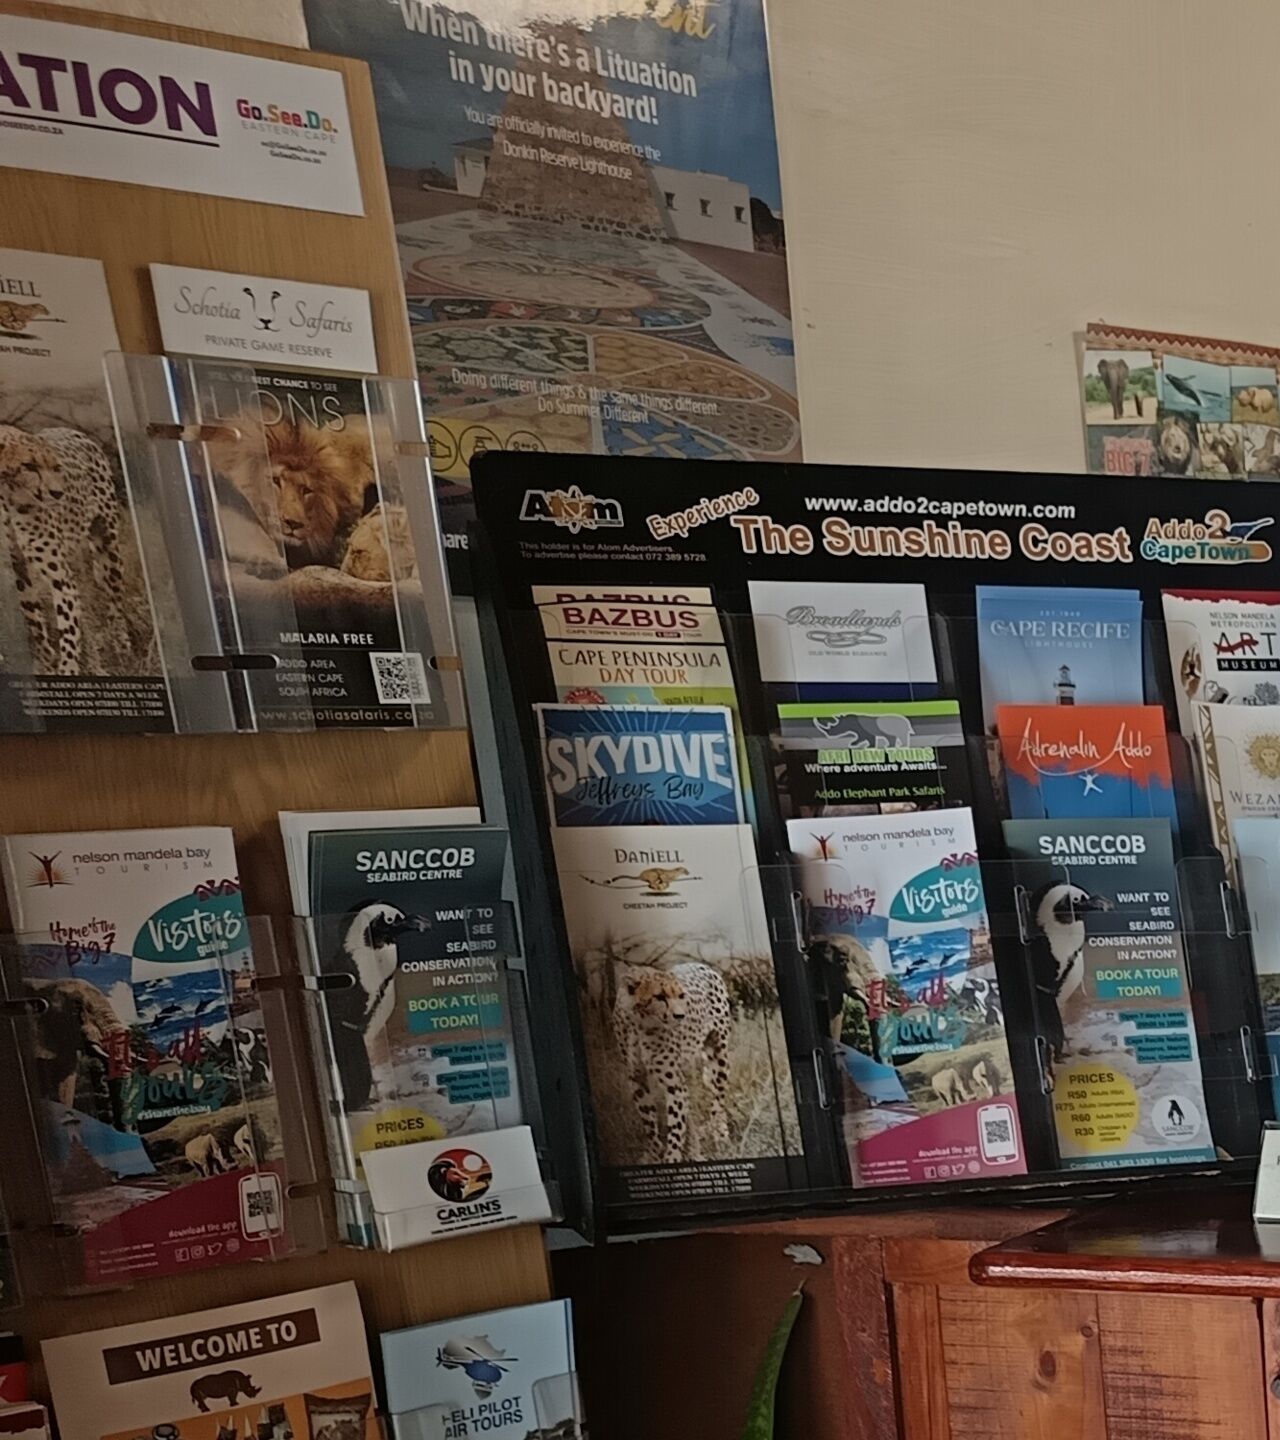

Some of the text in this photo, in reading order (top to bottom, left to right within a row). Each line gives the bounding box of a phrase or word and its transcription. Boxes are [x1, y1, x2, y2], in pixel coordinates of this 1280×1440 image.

[400, 1, 698, 97] When there's a Lituation
[448, 50, 660, 125] in your backyard!
[464, 104, 662, 162] You are officially invited to experience the
[503, 140, 633, 181] Donkin Reserve Lighthouse
[174, 285, 353, 340] Schotia Safaris
[204, 334, 333, 359] PRIVATE GAME RESERVE
[206, 386, 347, 432] LIONS
[537, 396, 650, 424] Do Summer Different
[647, 486, 760, 540] Experience
[805, 495, 1076, 520] www.addo2capetown.com
[731, 514, 1134, 563] The Sunshine Coast
[562, 606, 700, 629] BAZBUS
[1209, 611, 1275, 621] NELSON MANDELA
[1210, 620, 1277, 629] METROPOLITAN
[279, 632, 375, 645] MALARIA FREE
[990, 620, 1131, 639] CAPE RECIFE
[1216, 631, 1277, 656] ART
[558, 649, 722, 668] CAPE PENINSULA
[1220, 660, 1278, 670] MUSEUM
[600, 667, 689, 685] DAY TOUR
[548, 733, 733, 795] SKYDIVE
[576, 775, 704, 805] Jeffreys Bay
[842, 787, 887, 800] Elephant
[889, 786, 910, 799] Park
[913, 785, 946, 797] Safaris
[842, 825, 954, 844] nelson mandela bay
[1038, 834, 1147, 855] SANCCOB
[72, 847, 211, 864] nelson mandela bay
[355, 847, 475, 871] SANCCOB
[1051, 854, 1138, 866] SEABIRD CENTRE
[367, 869, 463, 884] SEABIRD CENTRE
[865, 898, 876, 916] 7
[1116, 892, 1169, 904] WANT TO
[435, 906, 494, 921] WANT TO
[1150, 905, 1171, 918] SEE
[472, 923, 494, 936] SEE
[1128, 920, 1175, 931] SEABIRD
[64, 932, 116, 968] Big 7
[446, 939, 497, 953] SEABIRD
[1088, 934, 1173, 948] CONSERVATION
[1117, 948, 1177, 961] IN ACTION?
[401, 955, 497, 973] CONSERVATION
[432, 975, 445, 988] IN
[1095, 967, 1179, 982] BOOK A TOUR
[1116, 984, 1162, 998] TODAY!
[407, 992, 500, 1013] BOOK A TOUR
[430, 1013, 480, 1030] TODAY!
[1069, 1073, 1115, 1085] PRICES
[376, 1117, 426, 1134] PRICES
[135, 1319, 298, 1373] WELCOME TO
[478, 1395, 522, 1417] PILOT
[445, 1409, 523, 1440] AIR TOURS
